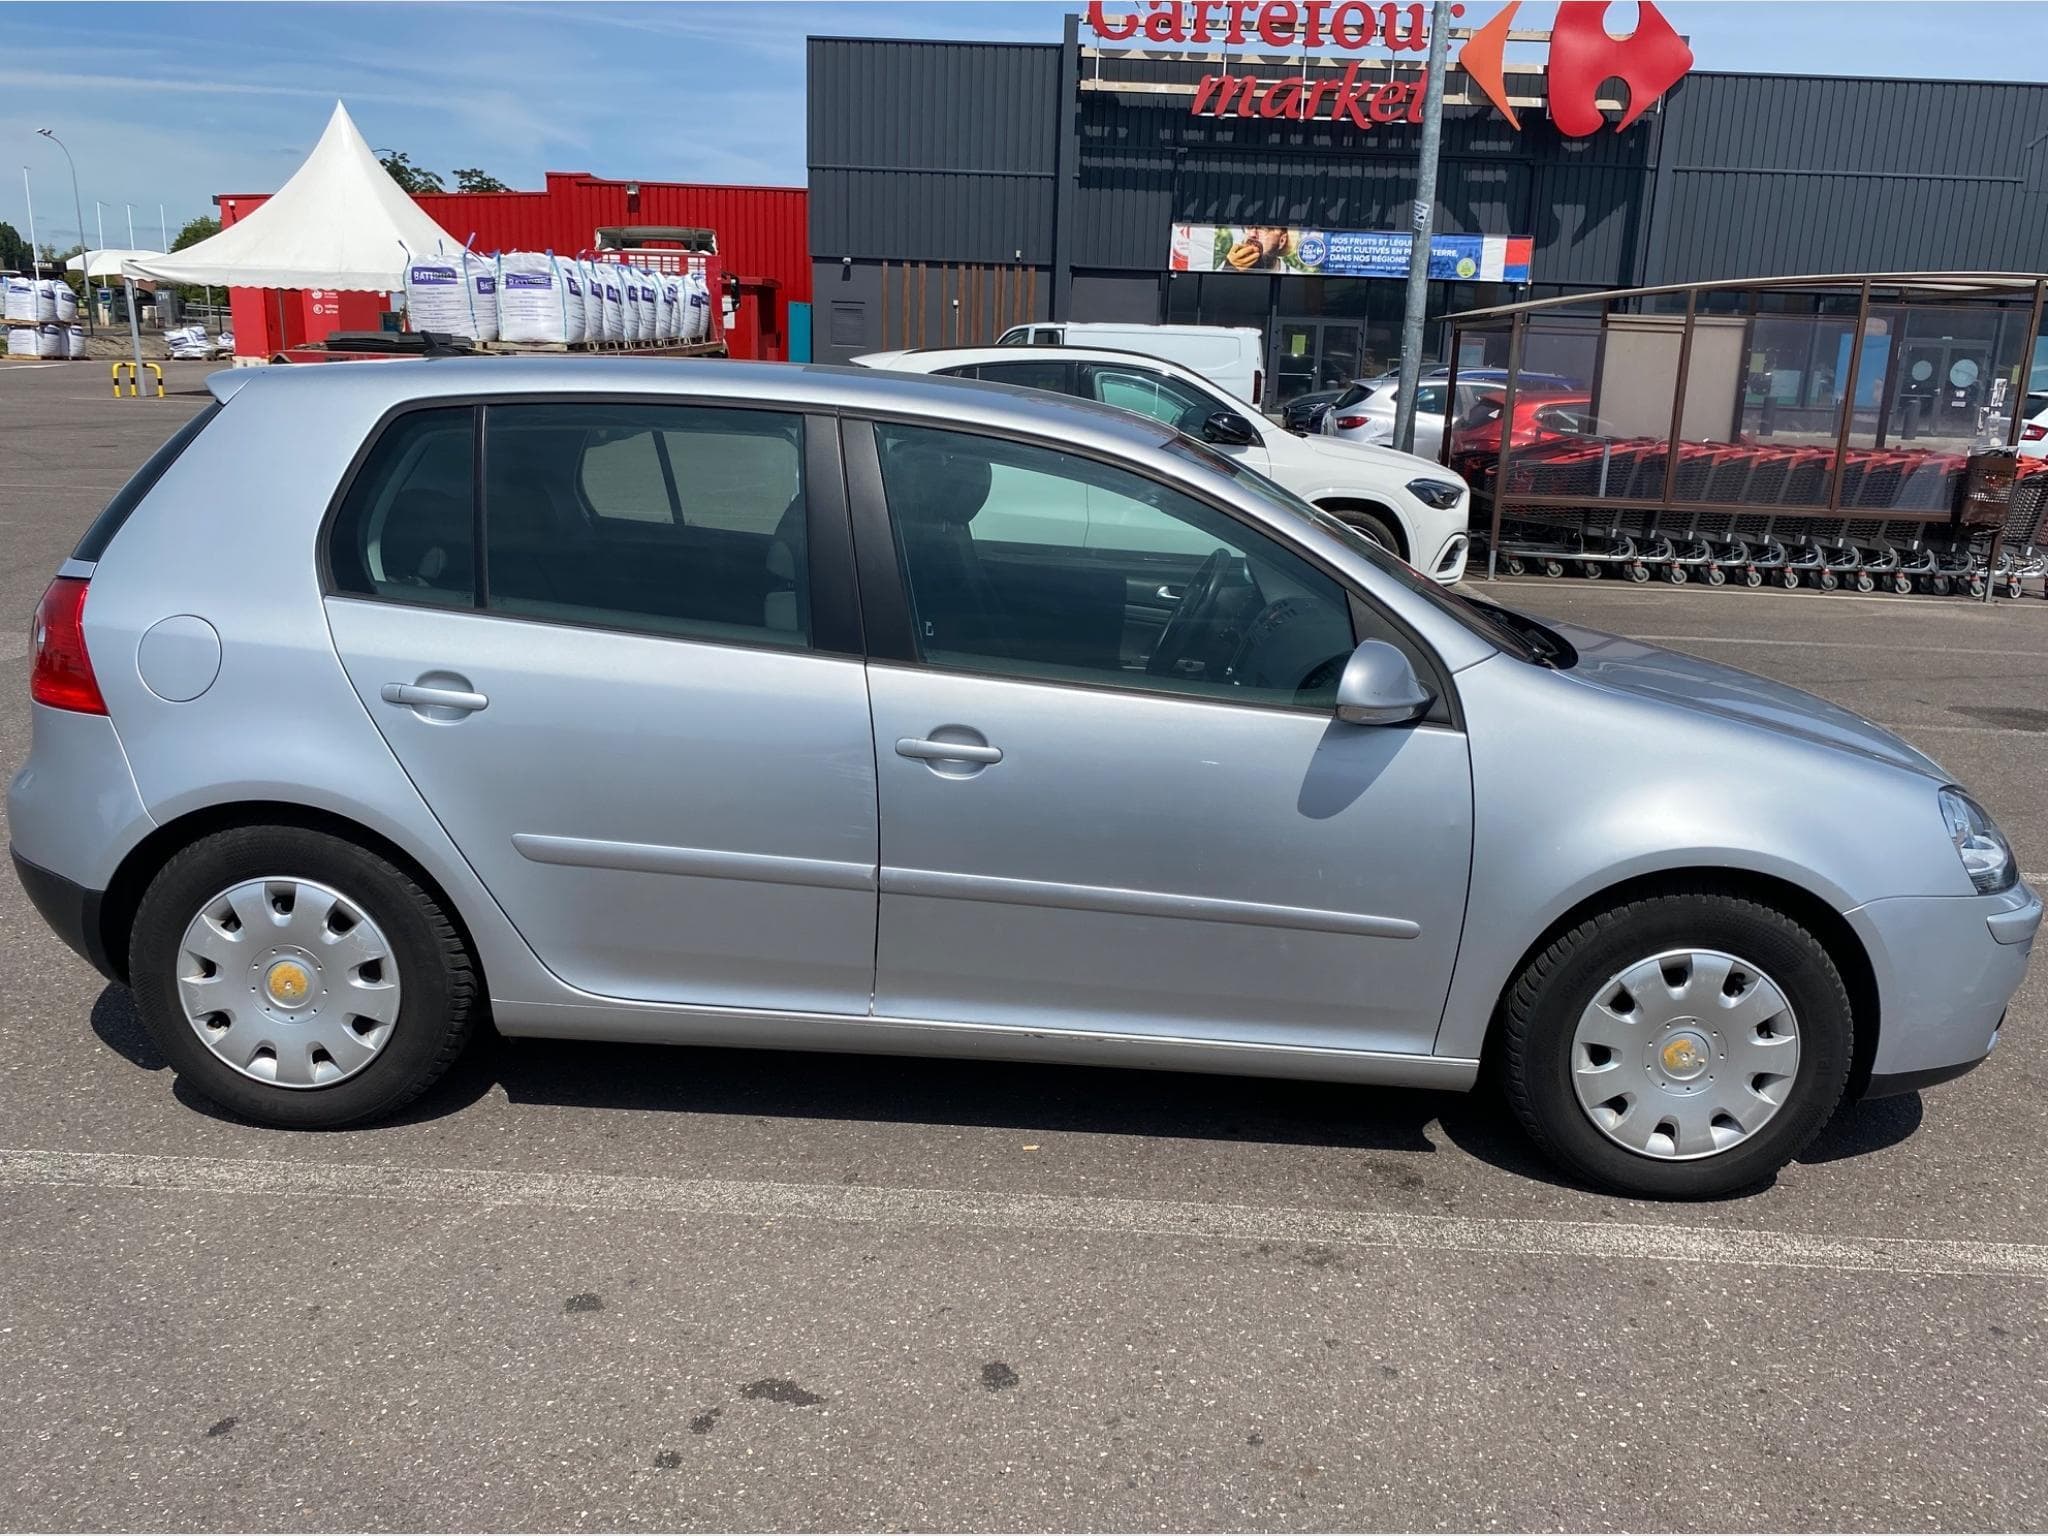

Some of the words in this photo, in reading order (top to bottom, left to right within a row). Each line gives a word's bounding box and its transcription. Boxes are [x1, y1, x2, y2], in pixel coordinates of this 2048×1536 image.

[1192, 61, 1427, 130] market
[1331, 237, 1348, 245] NOS
[1379, 238, 1388, 246] ET
[1330, 245, 1353, 253] SONT
[1329, 254, 1352, 262] DANS
